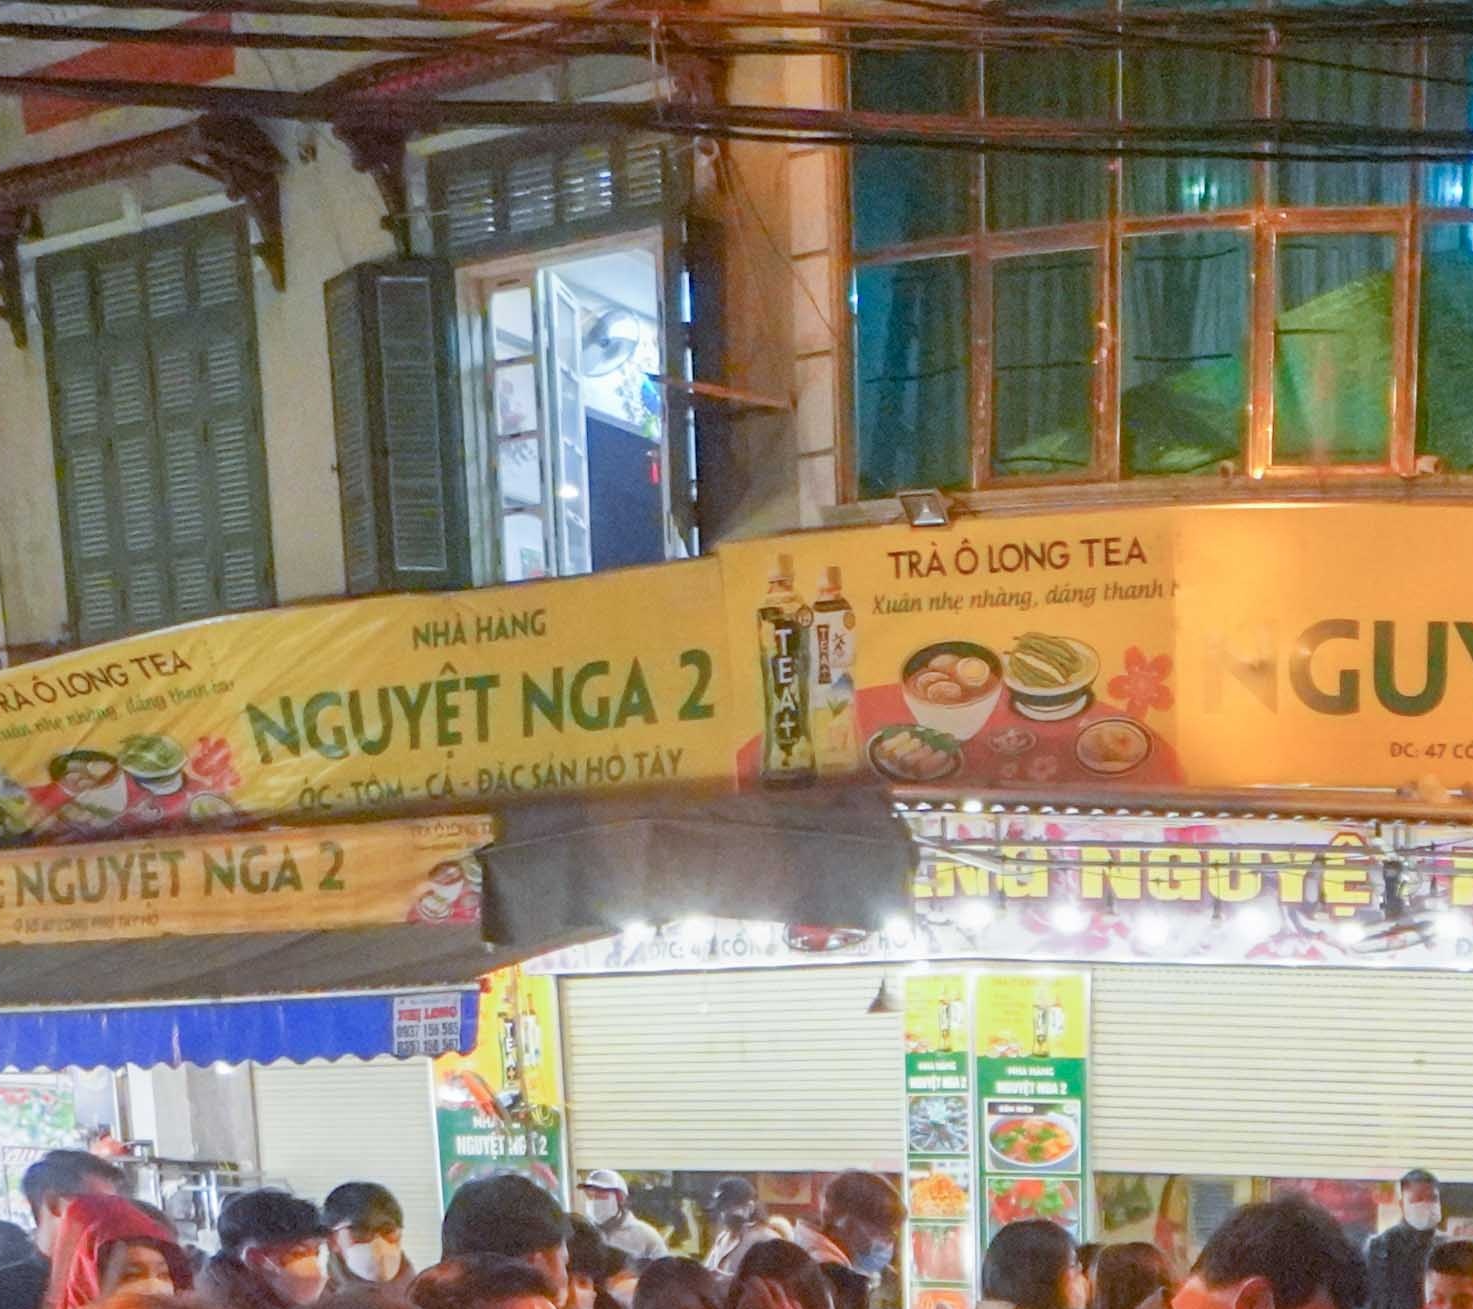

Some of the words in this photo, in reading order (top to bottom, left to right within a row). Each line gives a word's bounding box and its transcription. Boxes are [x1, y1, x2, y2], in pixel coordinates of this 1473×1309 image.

[888, 541, 945, 581] TRÀ
[954, 537, 979, 575] Ô
[988, 540, 1071, 574] LONG
[1081, 536, 1147, 569] TEA
[871, 592, 923, 616] Xuân
[929, 590, 966, 616] nhẹ
[970, 586, 1037, 613] nhàng,
[1103, 579, 1165, 604] thanh
[413, 615, 468, 651] NHÀ
[474, 607, 548, 643] HÀNG
[32, 674, 55, 705] Ô
[57, 664, 129, 700] LONG
[131, 650, 193, 682] TEA
[245, 661, 500, 764] NGUYỆT
[521, 655, 659, 739] NGA
[677, 648, 715, 721] 2
[1423, 743, 1447, 763] 47
[11, 844, 185, 910] NGUYỆT
[201, 847, 300, 896] NGA
[318, 841, 347, 892] 2
